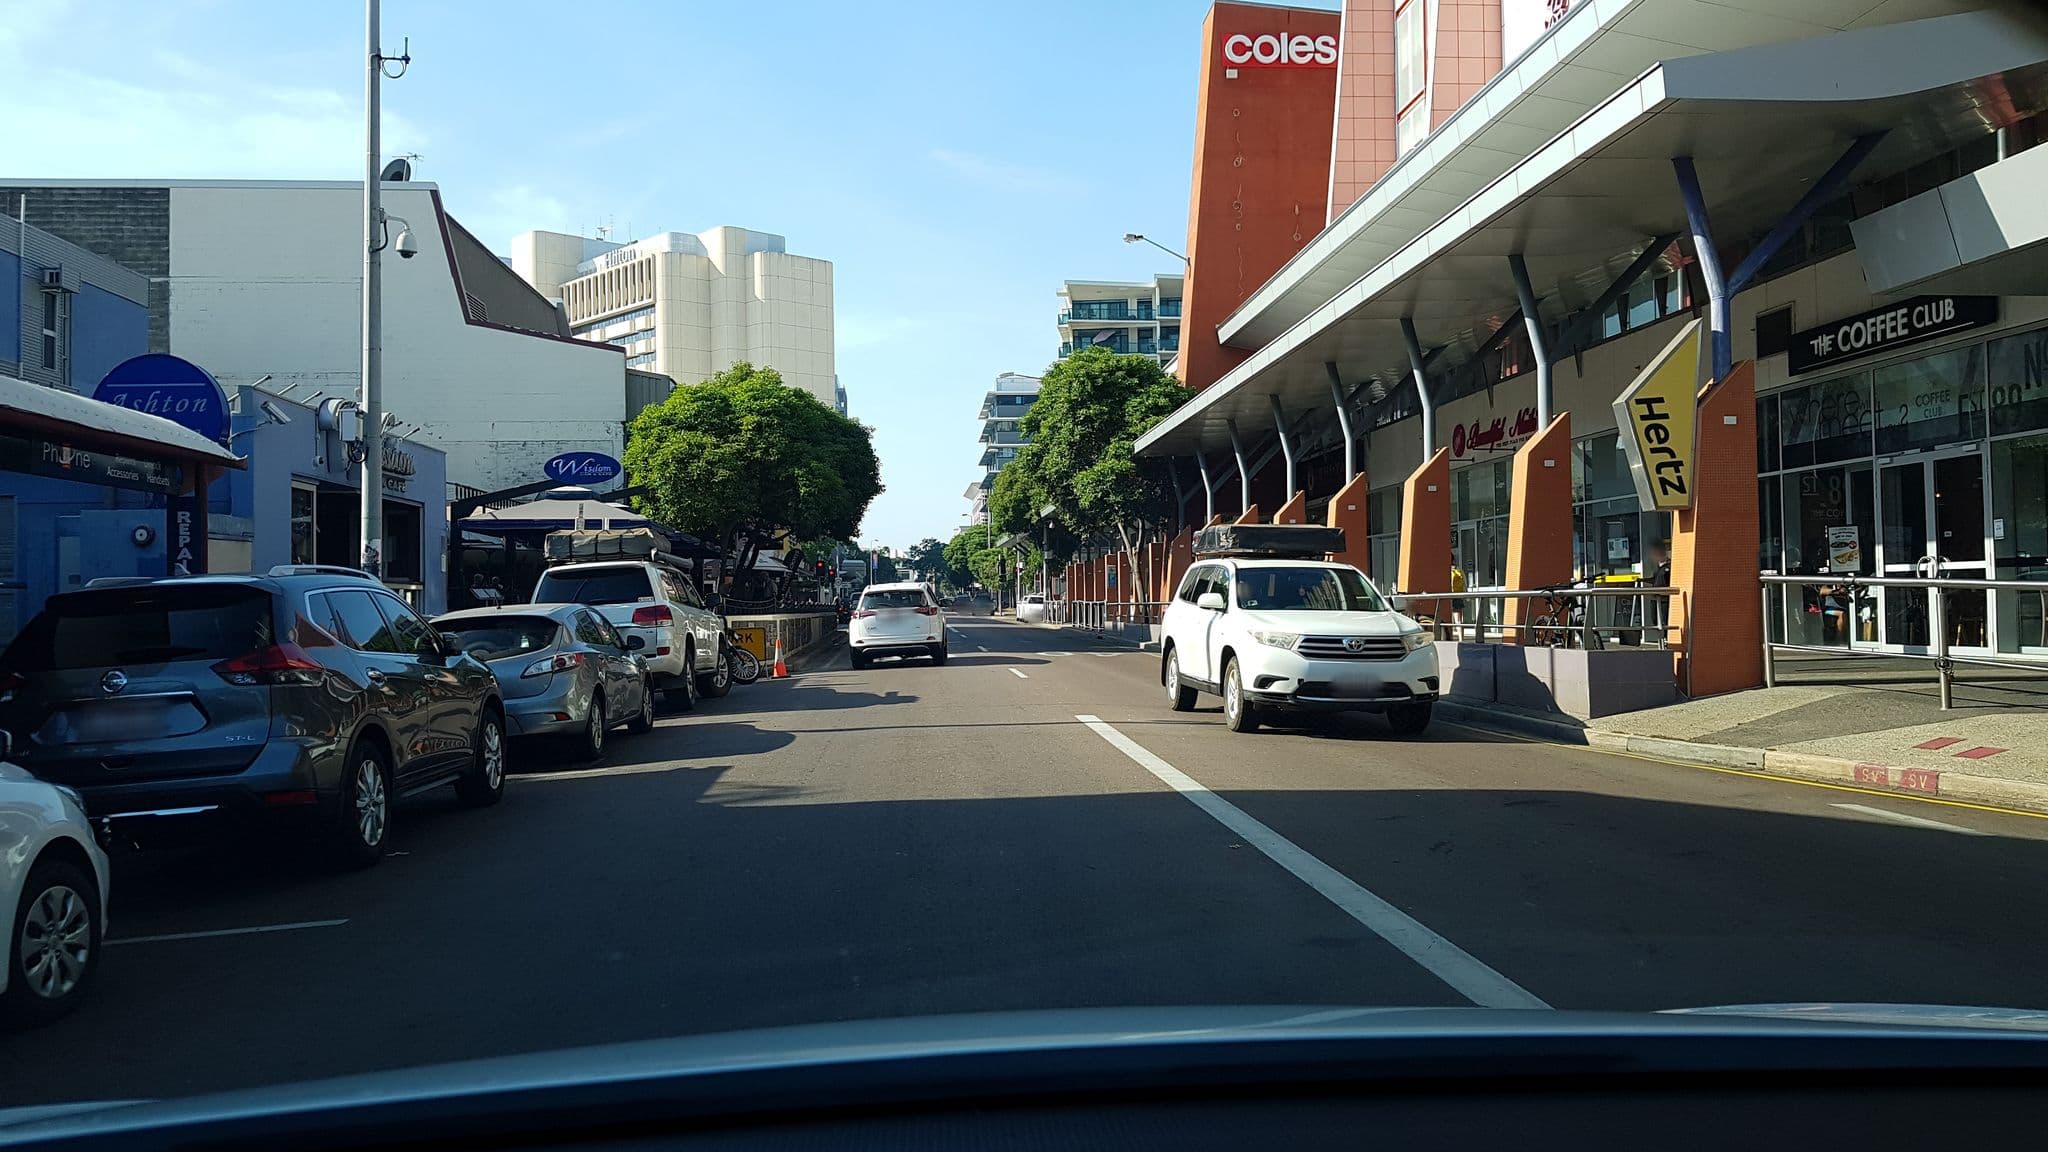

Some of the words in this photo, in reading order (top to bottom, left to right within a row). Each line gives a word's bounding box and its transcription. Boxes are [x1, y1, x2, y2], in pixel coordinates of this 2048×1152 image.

[1225, 32, 1337, 64] coles
[1810, 334, 1835, 357] THE
[1837, 307, 1909, 352] COFFEE
[1912, 298, 1955, 328] CLUB
[113, 391, 207, 412] Ashton
[1915, 390, 1951, 407] COFFEE
[1634, 397, 1687, 496] Hertz
[552, 458, 611, 475] Wisdom
[731, 633, 753, 643] RK
